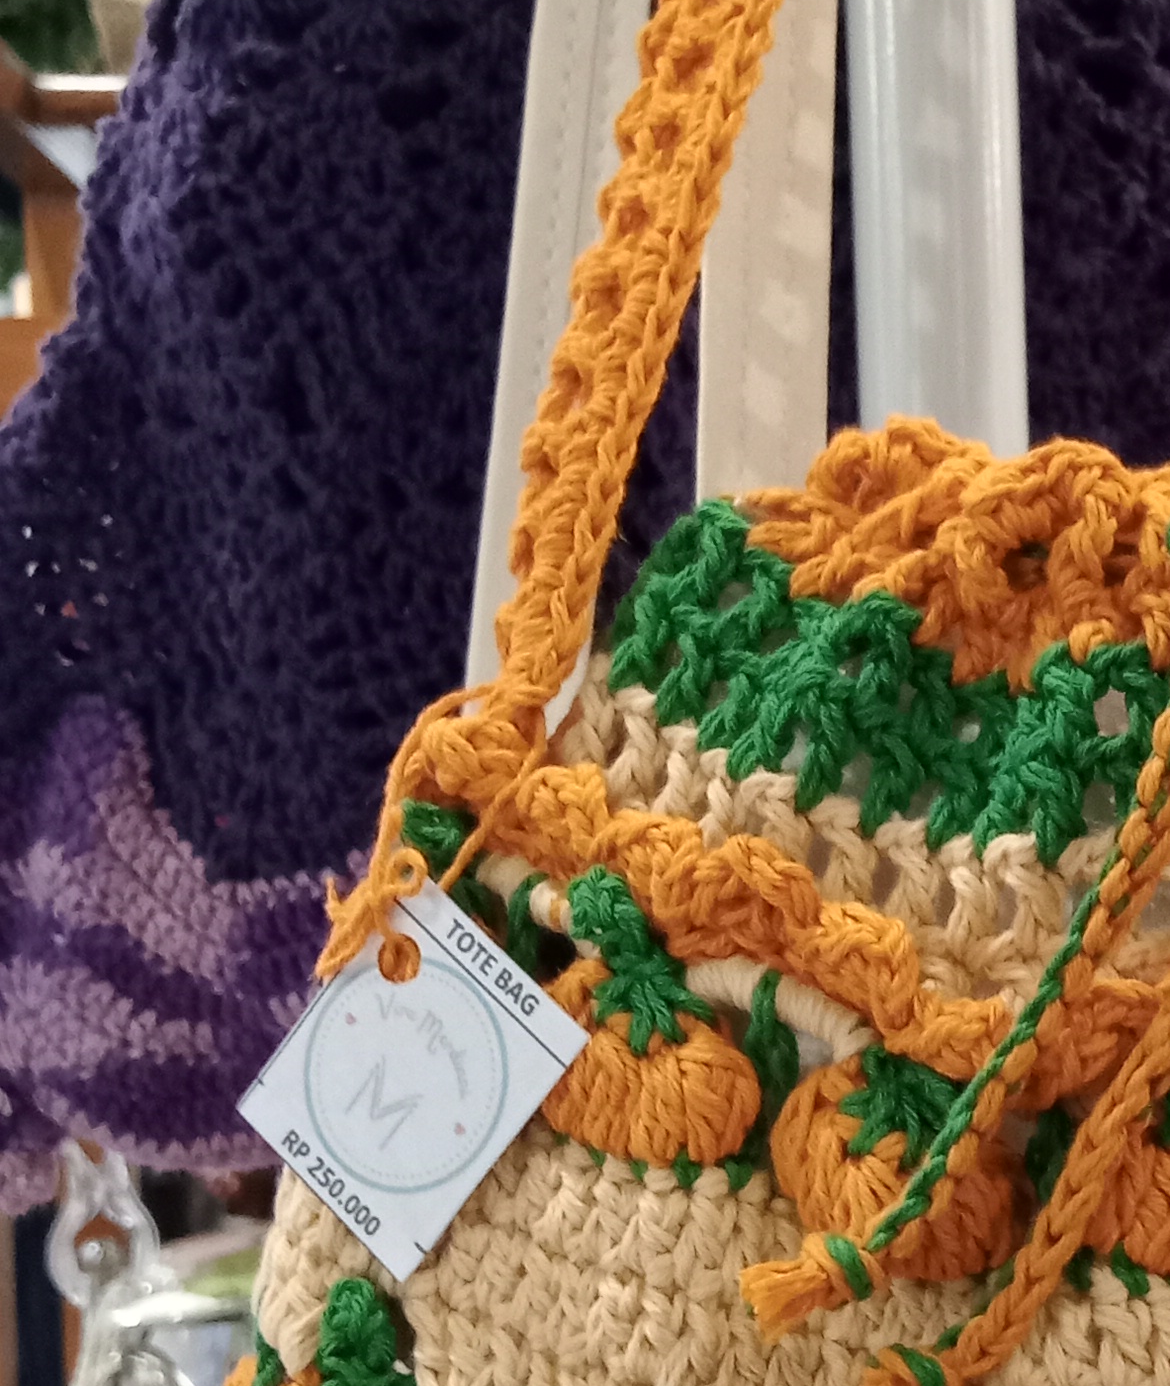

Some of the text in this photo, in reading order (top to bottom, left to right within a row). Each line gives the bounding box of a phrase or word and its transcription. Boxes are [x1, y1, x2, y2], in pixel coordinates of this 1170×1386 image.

[446, 917, 540, 1017] TOTE BAG
[281, 1129, 381, 1236] RP 250.000
